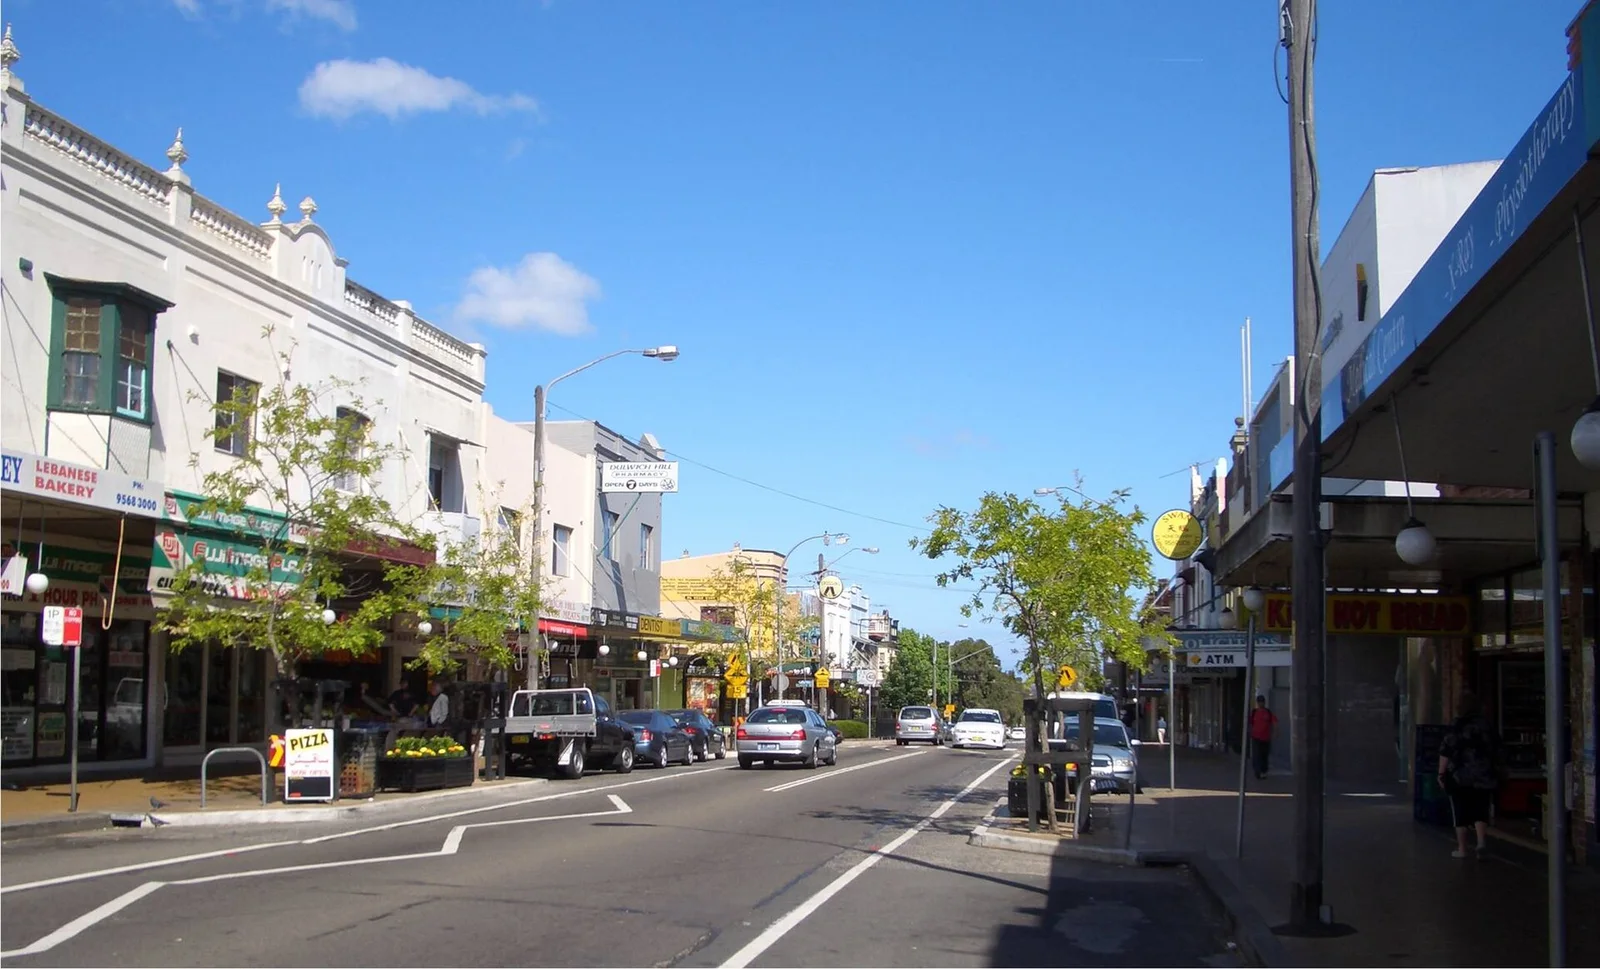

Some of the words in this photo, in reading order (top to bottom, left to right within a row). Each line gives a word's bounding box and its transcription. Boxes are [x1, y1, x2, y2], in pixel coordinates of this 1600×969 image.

[1494, 73, 1575, 242] Physiotherapy
[36, 460, 98, 484] LEBANESE
[35, 477, 95, 499] BAKERY
[116, 493, 137, 509] 9568
[138, 497, 157, 511] 3000
[44, 588, 78, 607] HOUR
[1334, 600, 1380, 630] HOT
[641, 618, 663, 633] DENTIST
[1205, 655, 1234, 664] ATM
[290, 732, 328, 751] PIZZA
